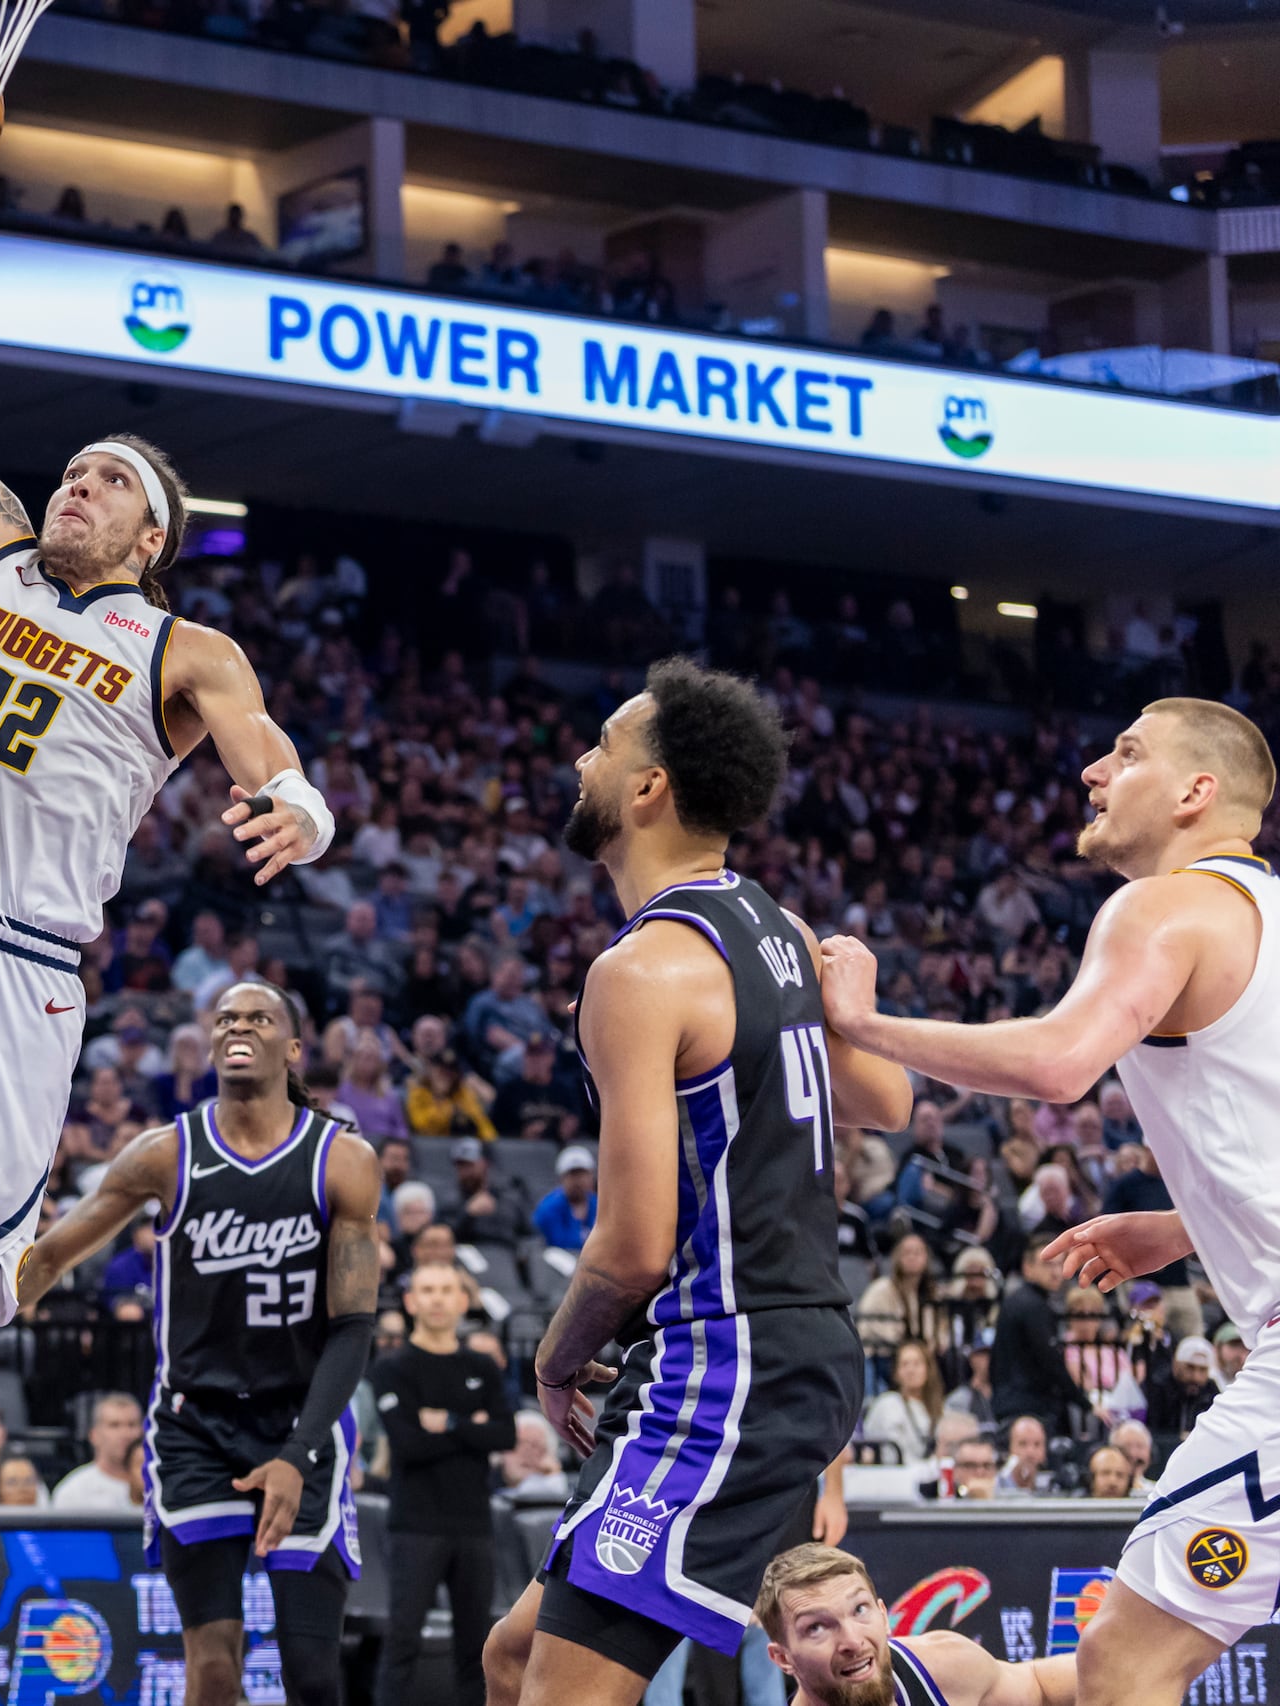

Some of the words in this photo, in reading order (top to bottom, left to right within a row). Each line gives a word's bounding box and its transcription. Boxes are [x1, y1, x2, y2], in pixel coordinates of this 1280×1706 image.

[269, 295, 540, 395] POWER
[583, 340, 874, 437] MARKET
[103, 610, 150, 638] ibotta
[183, 1208, 321, 1275] Kings
[246, 1269, 317, 1327] 23
